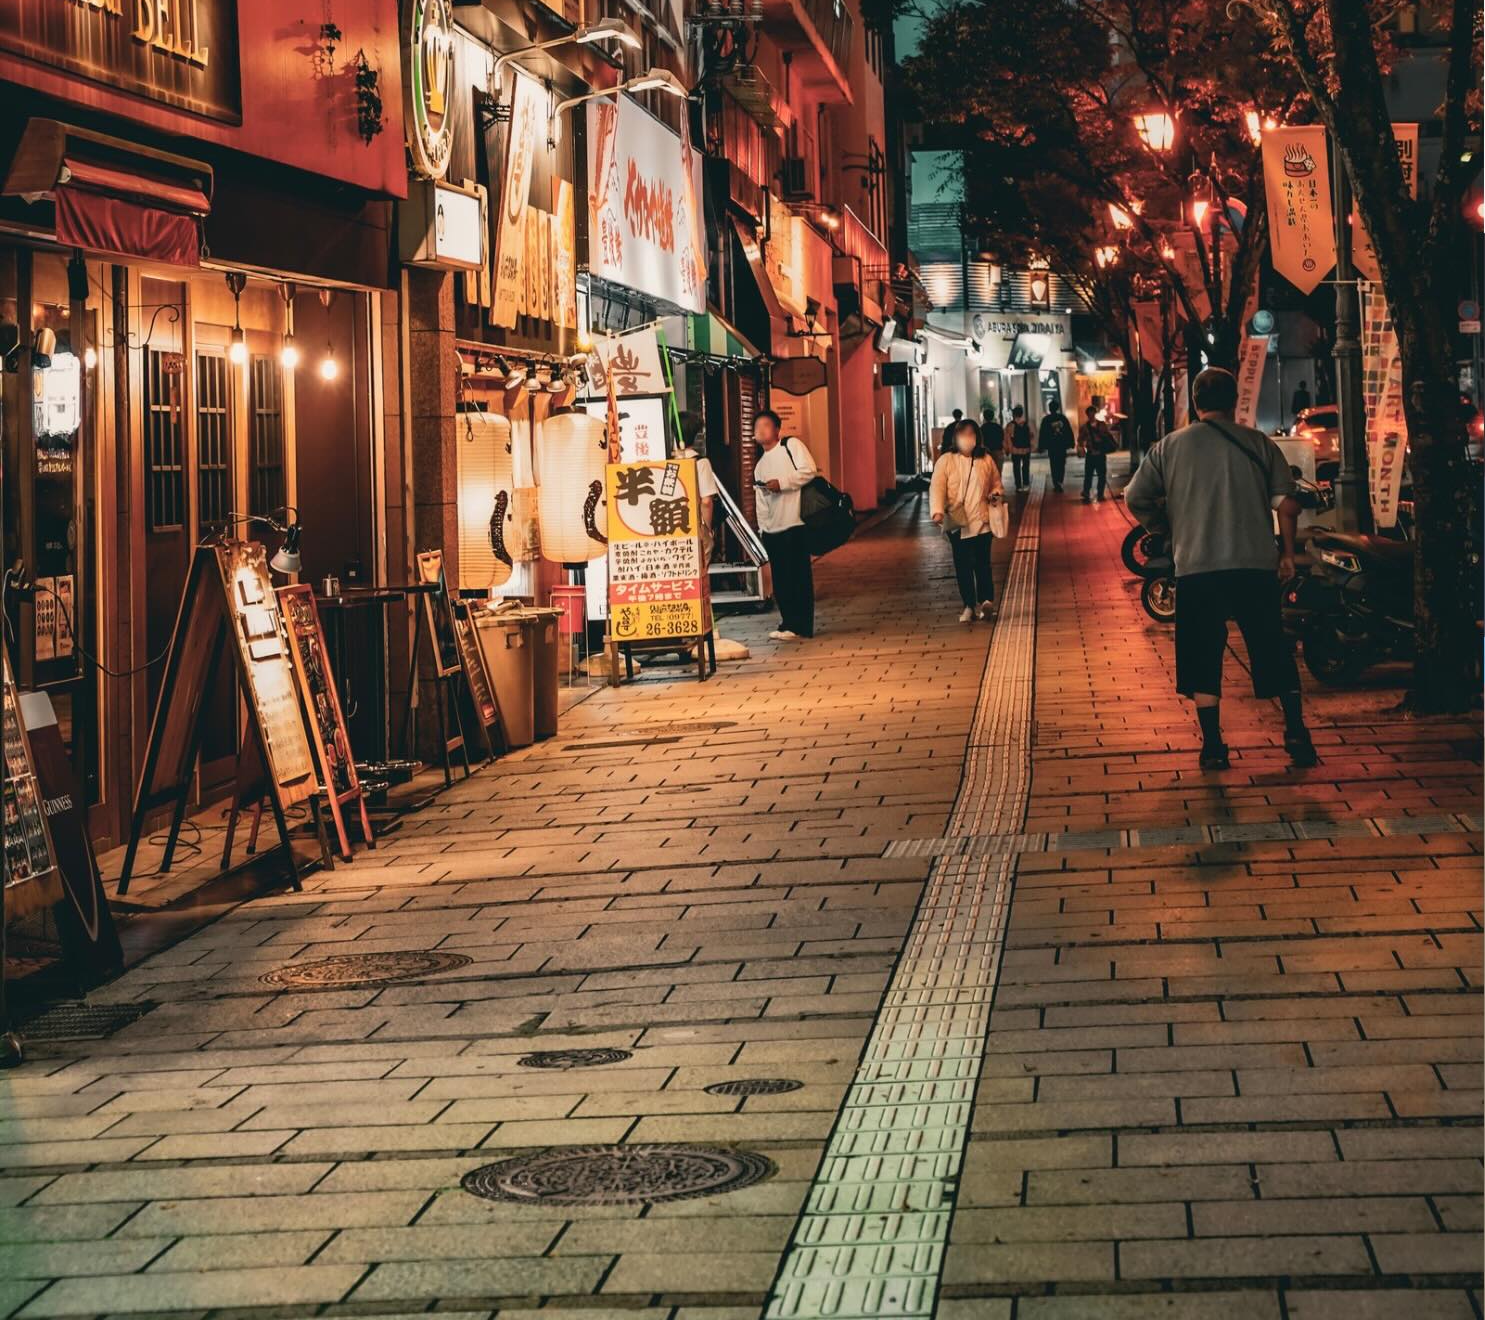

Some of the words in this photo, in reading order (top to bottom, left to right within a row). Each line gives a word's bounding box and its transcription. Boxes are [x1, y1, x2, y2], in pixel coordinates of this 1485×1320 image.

[1380, 432, 1398, 513] MONTH
[615, 580, 695, 595] タイムサービス
[646, 620, 698, 635] 26-3628
[43, 794, 73, 817] GUINNESS
